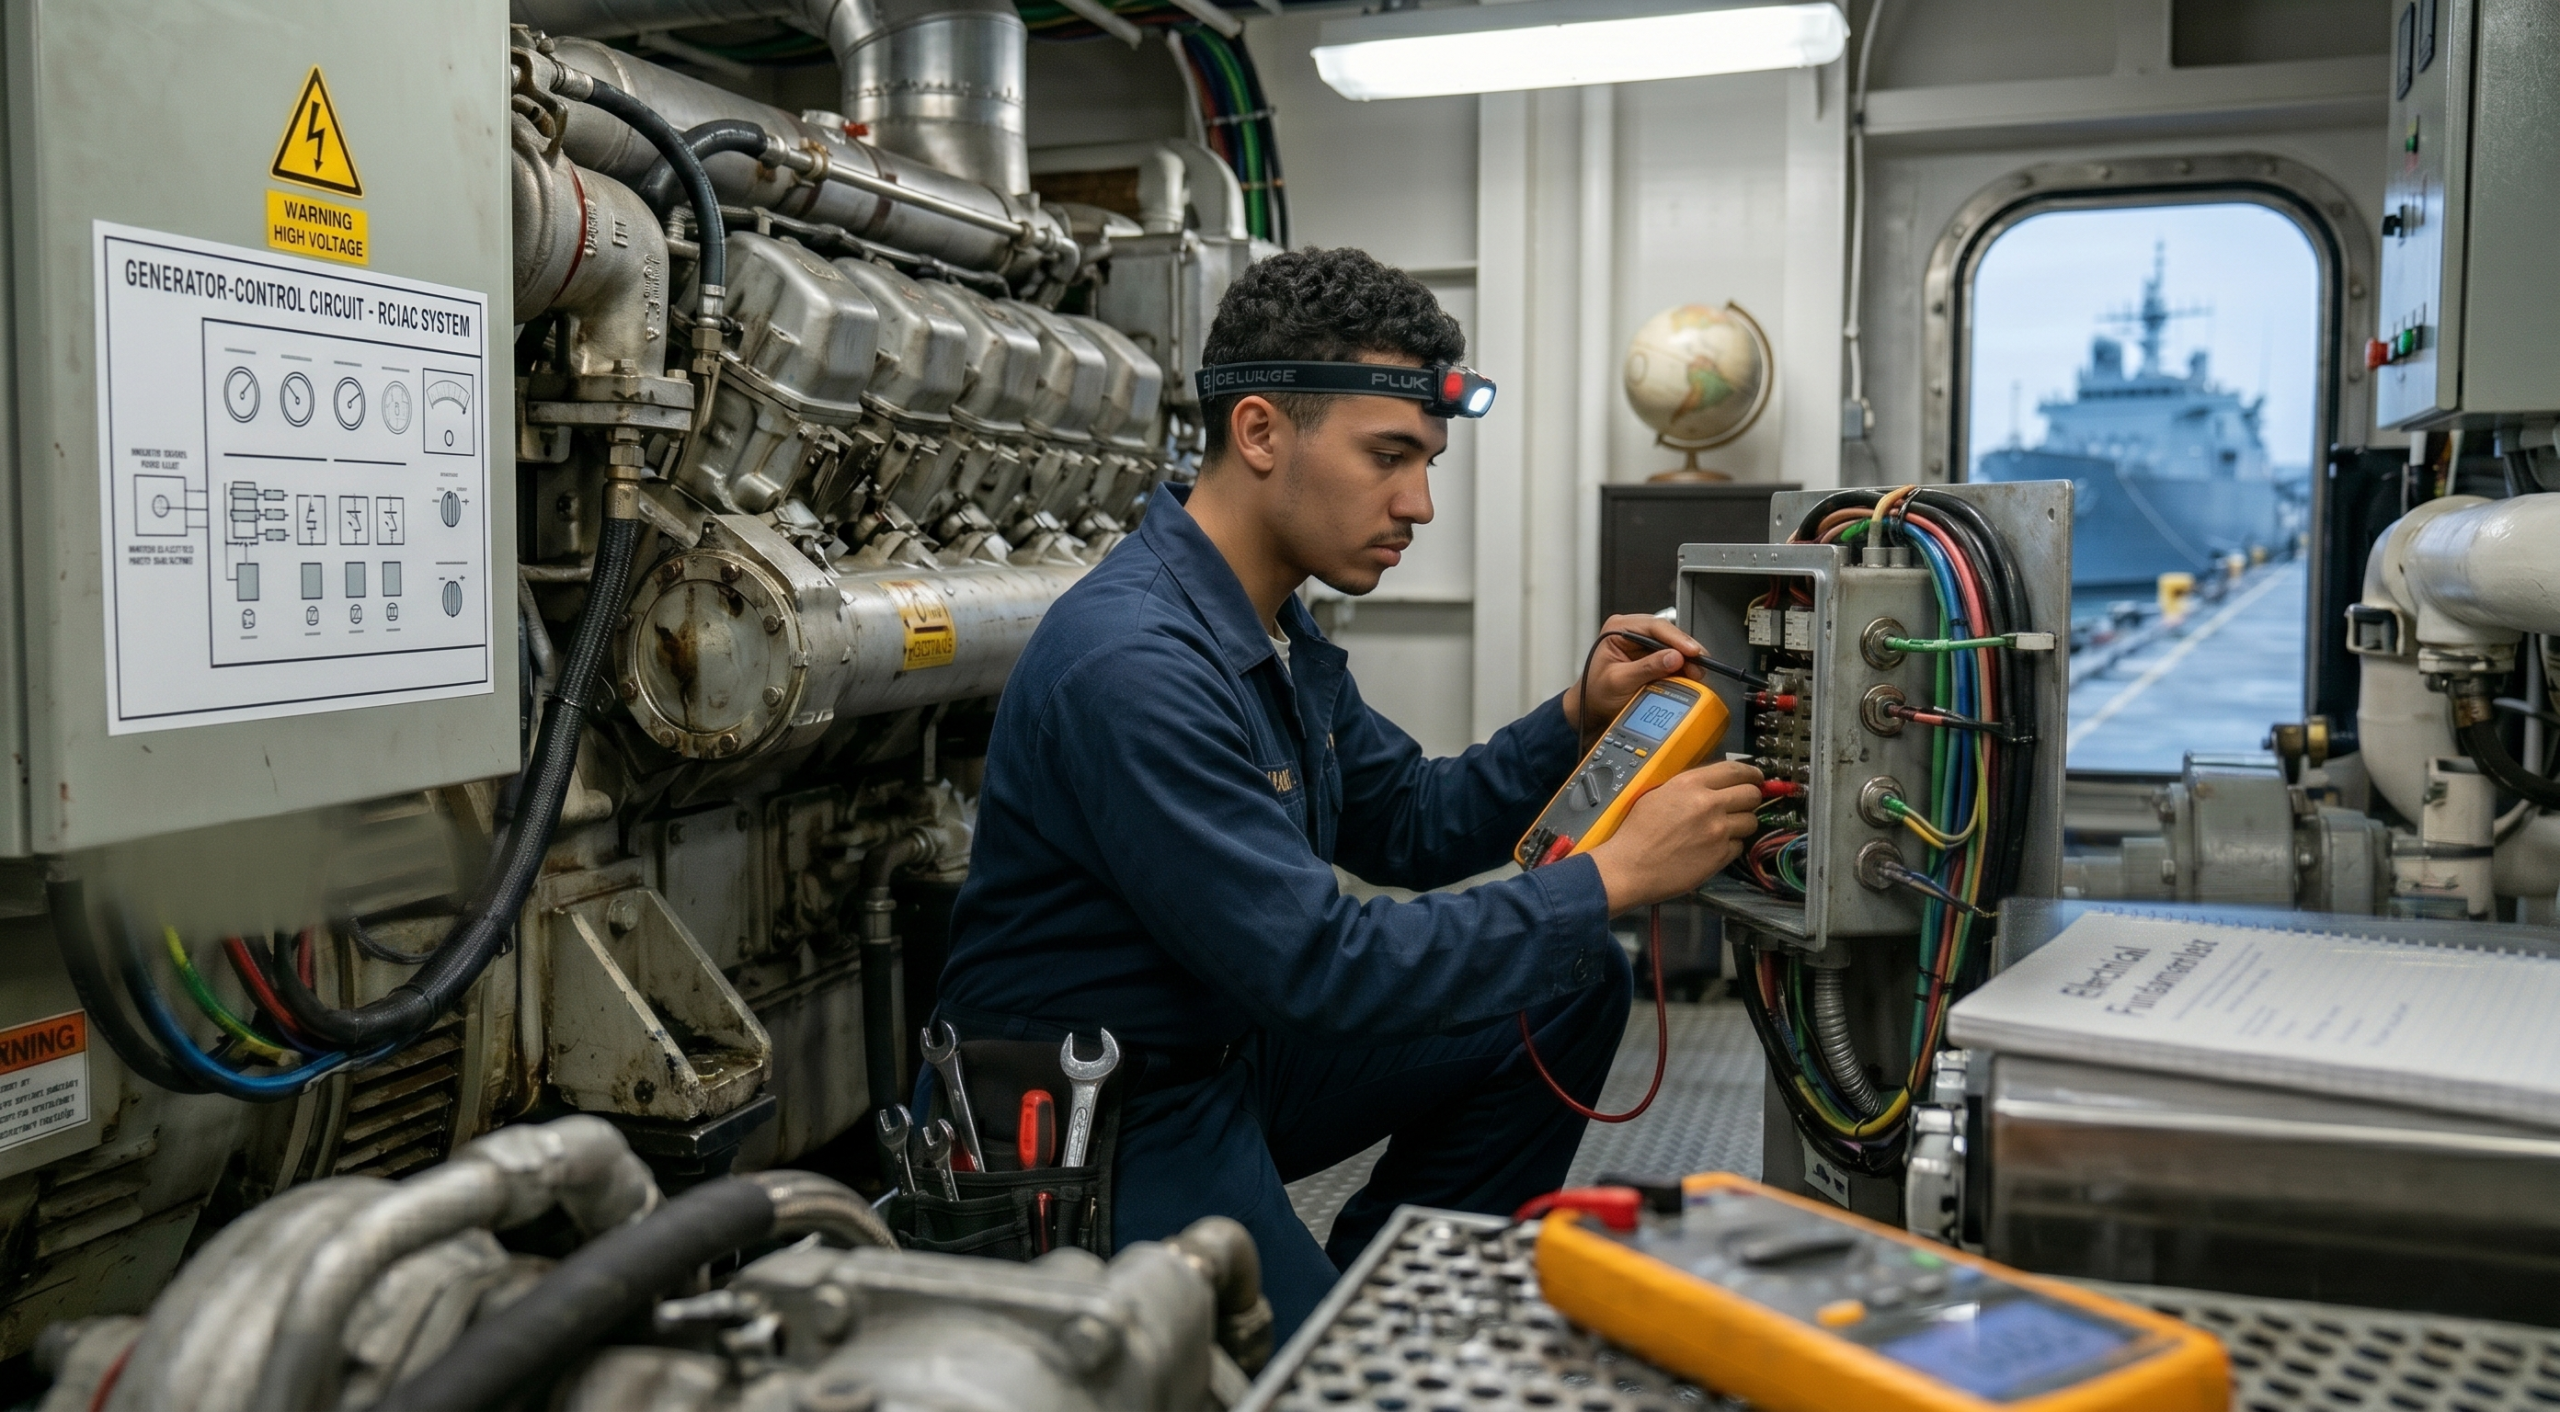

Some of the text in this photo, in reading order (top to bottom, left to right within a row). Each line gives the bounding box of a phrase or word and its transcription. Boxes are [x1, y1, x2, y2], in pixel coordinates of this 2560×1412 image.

[283, 199, 353, 231] WARNING
[273, 223, 364, 258] HIGH VOLTAGE
[125, 259, 306, 313] GENERATOR-CONTROL
[309, 289, 365, 321] CIRCUIT
[421, 307, 471, 338] SYSTEM
[1371, 373, 1428, 391] PLUK
